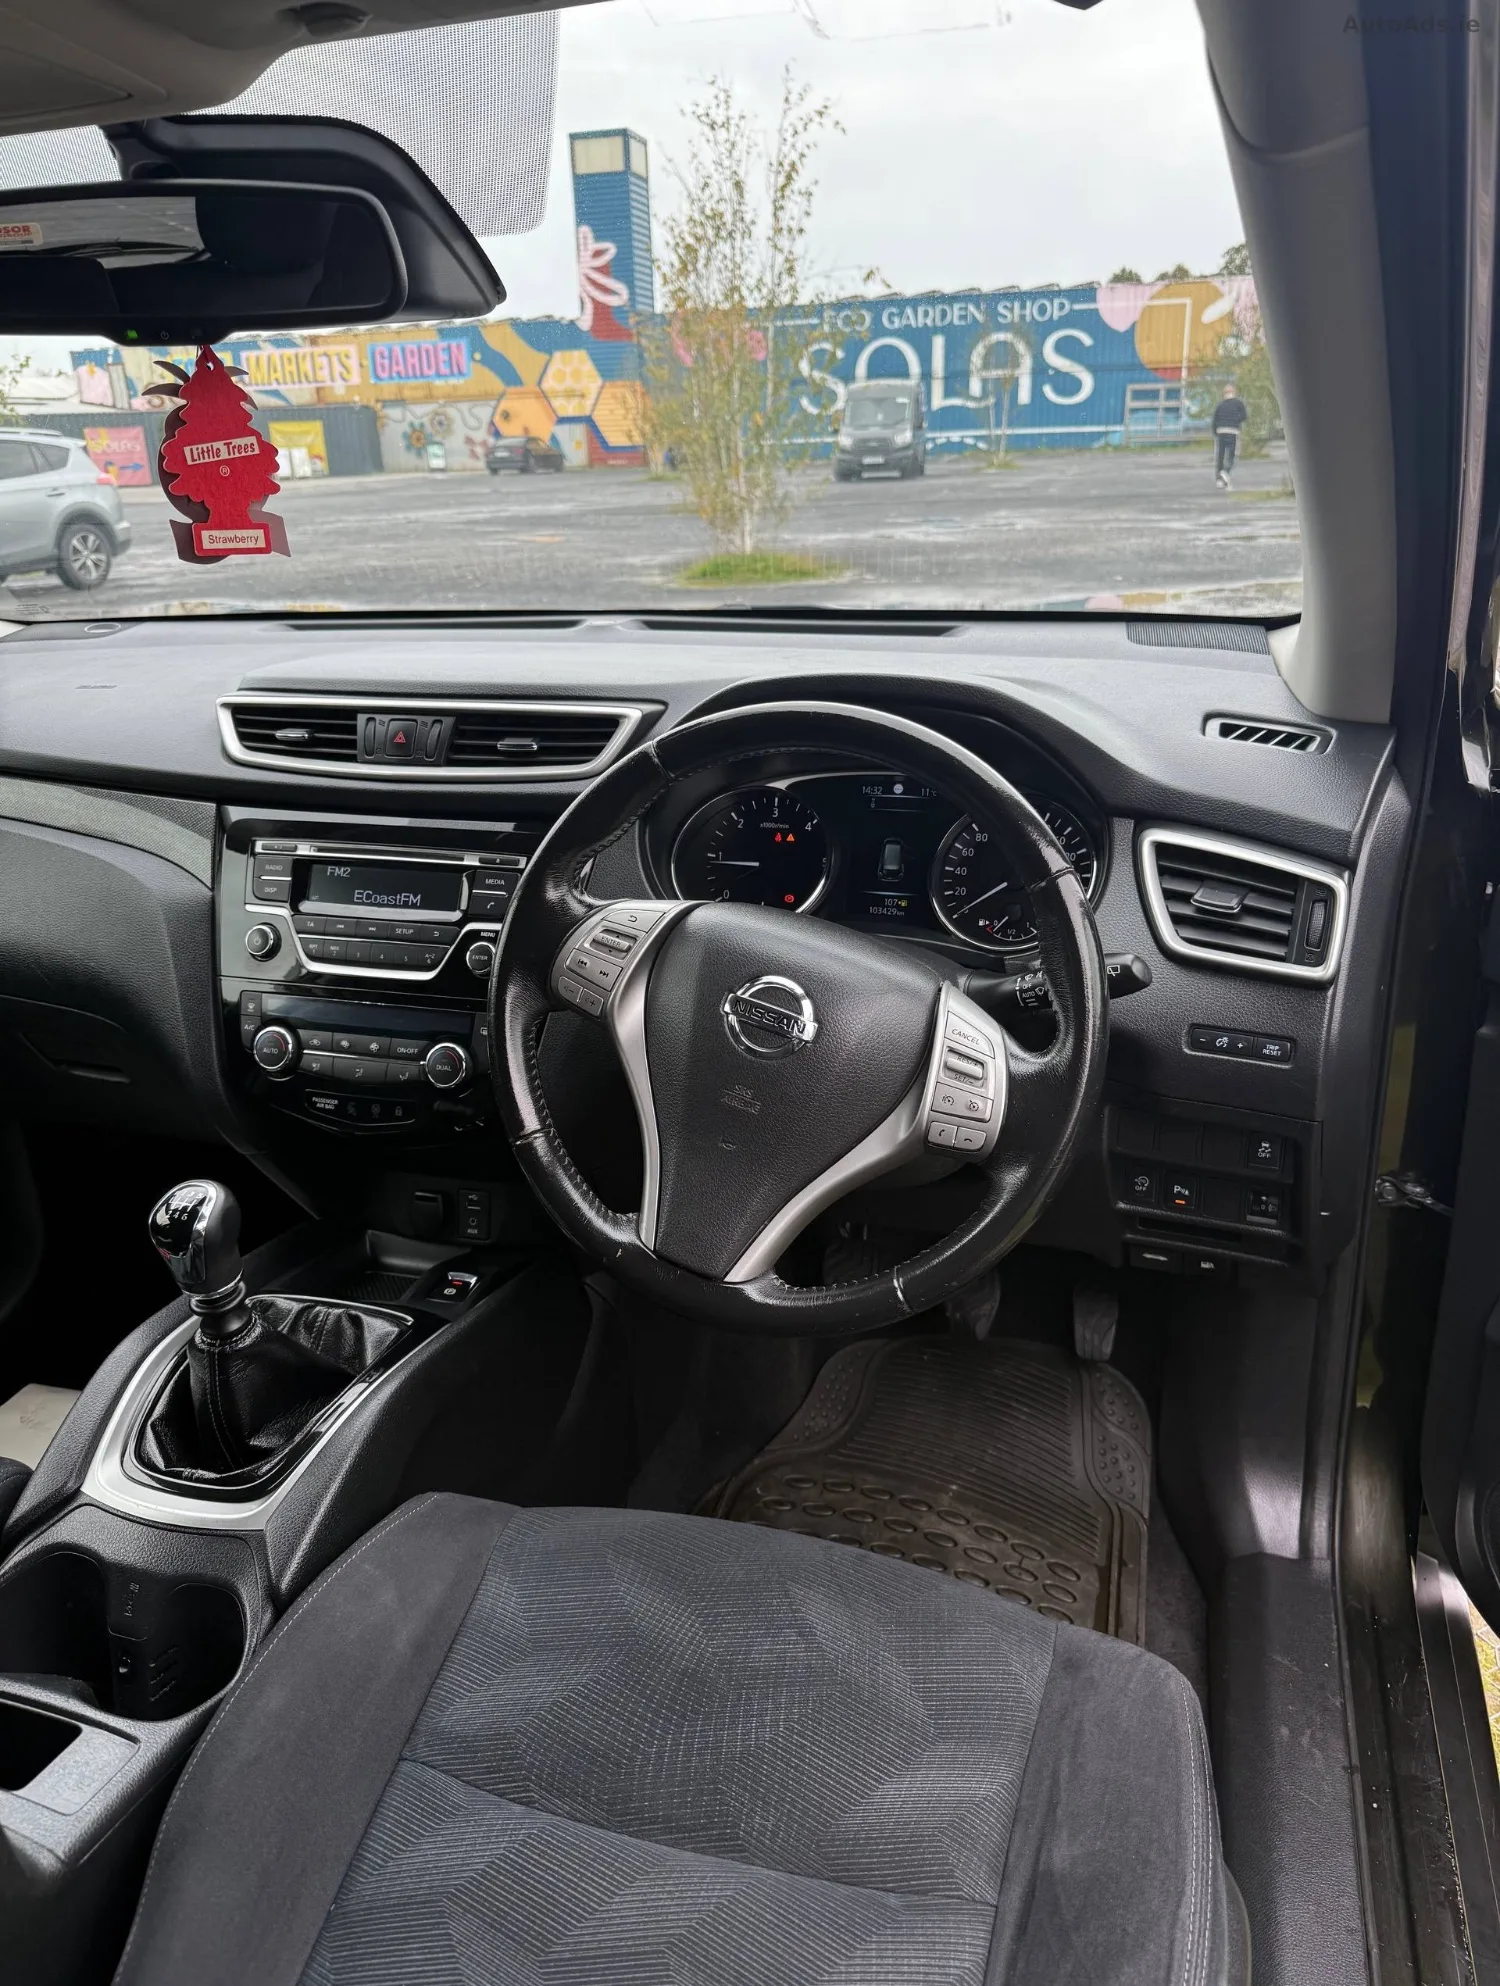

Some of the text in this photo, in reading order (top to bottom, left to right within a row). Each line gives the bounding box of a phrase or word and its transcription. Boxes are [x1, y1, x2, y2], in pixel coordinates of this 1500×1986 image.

[882, 302, 984, 329] GARDEN
[997, 299, 1071, 323] SHOP
[374, 343, 467, 380] GARDEN
[248, 348, 354, 386] MARKETS
[800, 328, 1095, 413] SOLAS
[189, 441, 256, 463] Little Trees
[208, 534, 259, 545] Strawberry
[862, 786, 883, 795] 14:32
[772, 807, 779, 818] 3
[737, 819, 744, 829] 2
[805, 822, 812, 832] 4
[975, 833, 988, 842] 80
[961, 848, 974, 857] 60
[327, 865, 351, 878] FM2
[954, 867, 967, 876] 40
[485, 878, 505, 886] MEDIA
[954, 886, 967, 895] 20
[353, 889, 422, 907] ECoastFM
[885, 898, 898, 906] 107
[601, 935, 621, 947] ENTER
[1022, 991, 1035, 999] AUTO
[733, 1000, 807, 1037] NISSAN
[951, 1028, 980, 1046] CANCEL
[435, 1064, 452, 1072] DUAL
[173, 1211, 180, 1219] 4
[181, 1213, 188, 1221] 6
